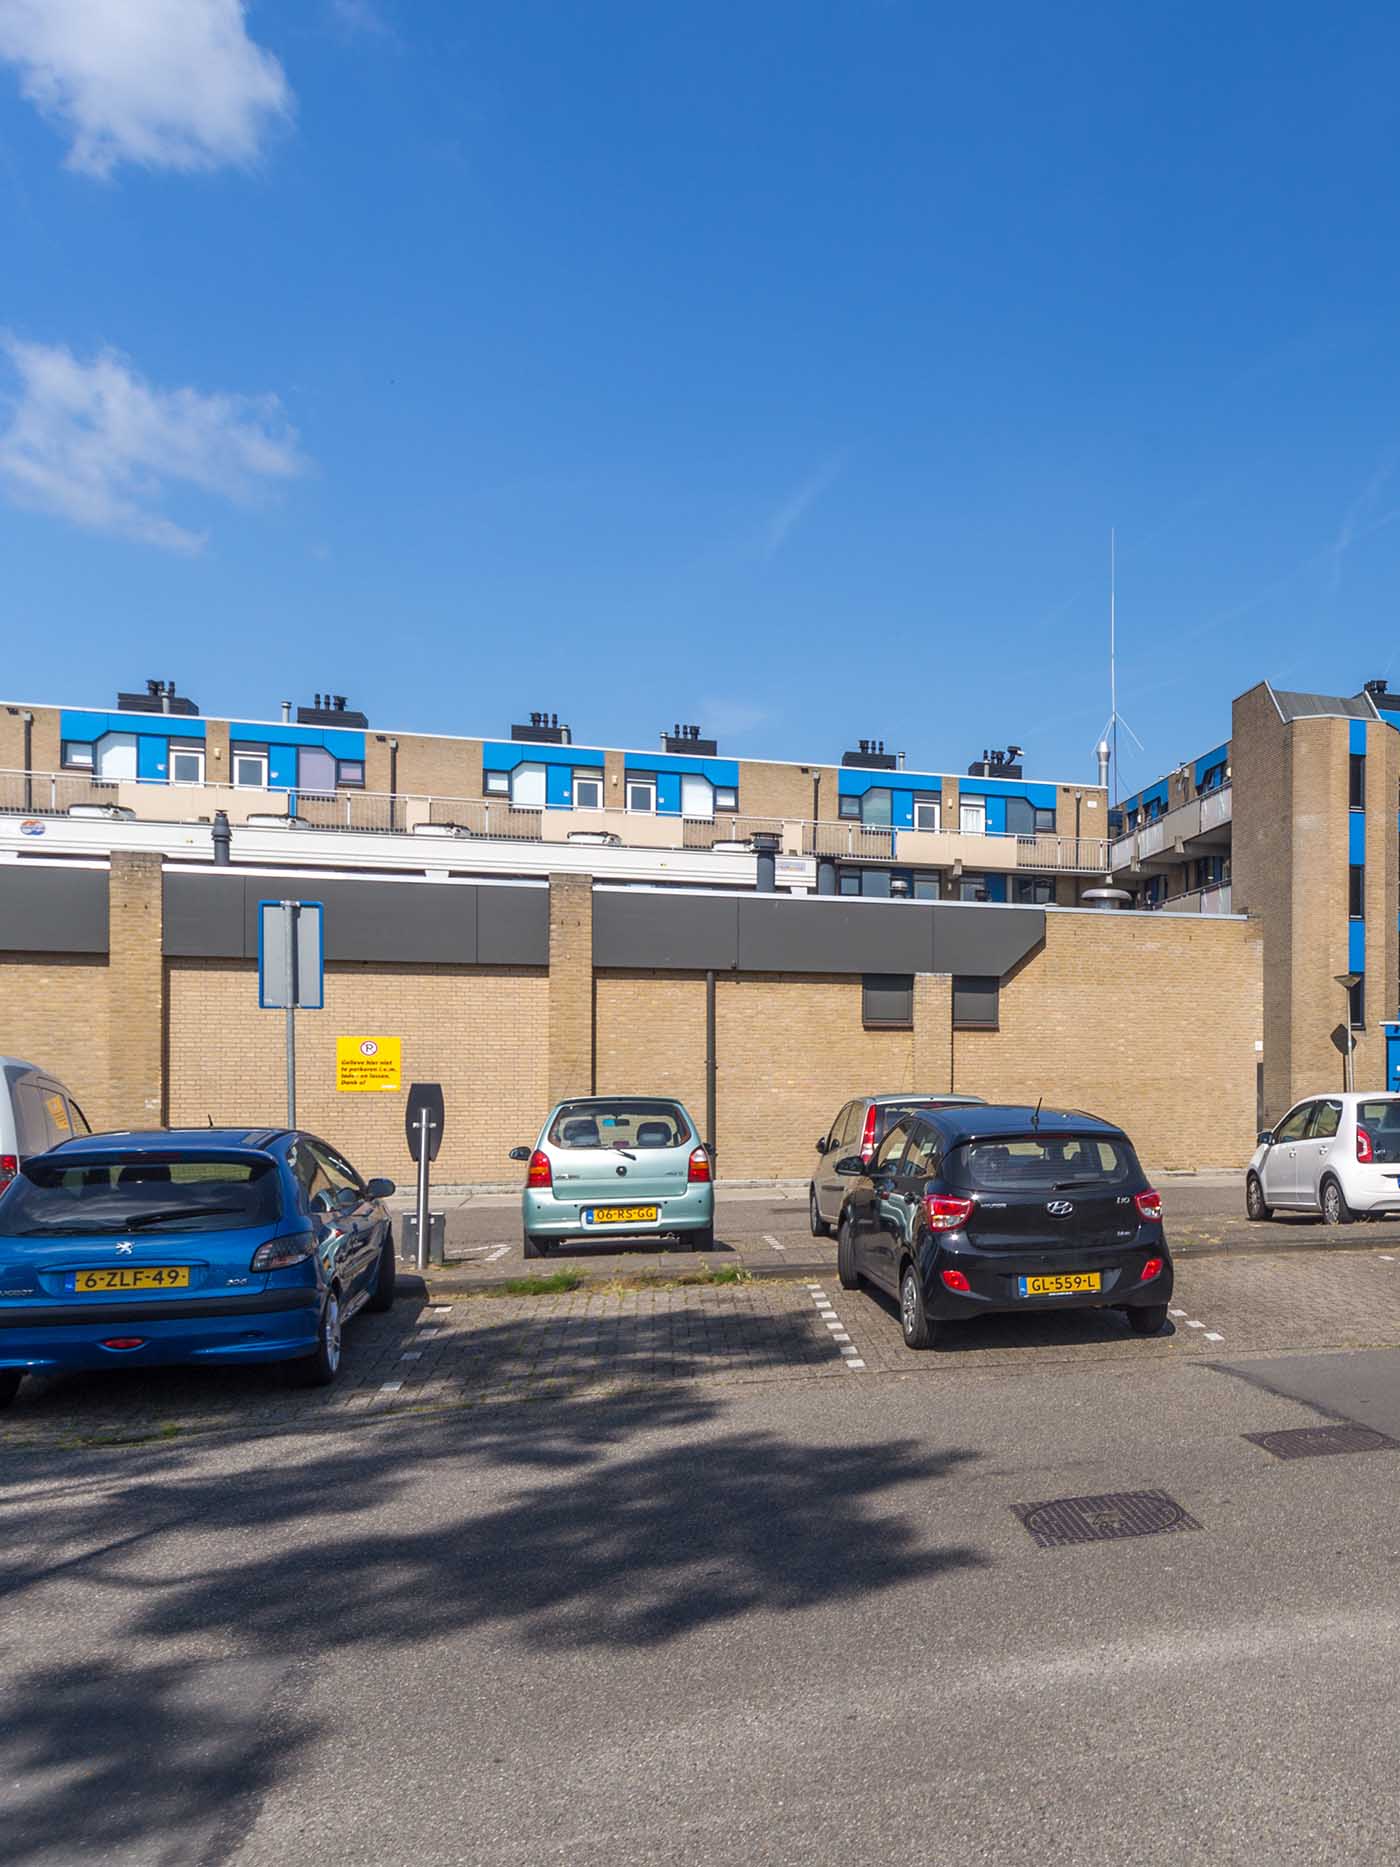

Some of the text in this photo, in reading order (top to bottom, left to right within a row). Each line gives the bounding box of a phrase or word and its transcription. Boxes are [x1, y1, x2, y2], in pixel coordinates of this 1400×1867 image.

[596, 1207, 654, 1220] 06-RS-GG
[84, 1269, 180, 1289] 6-ZLF-49
[1031, 1274, 1096, 1292] GL-559-L
